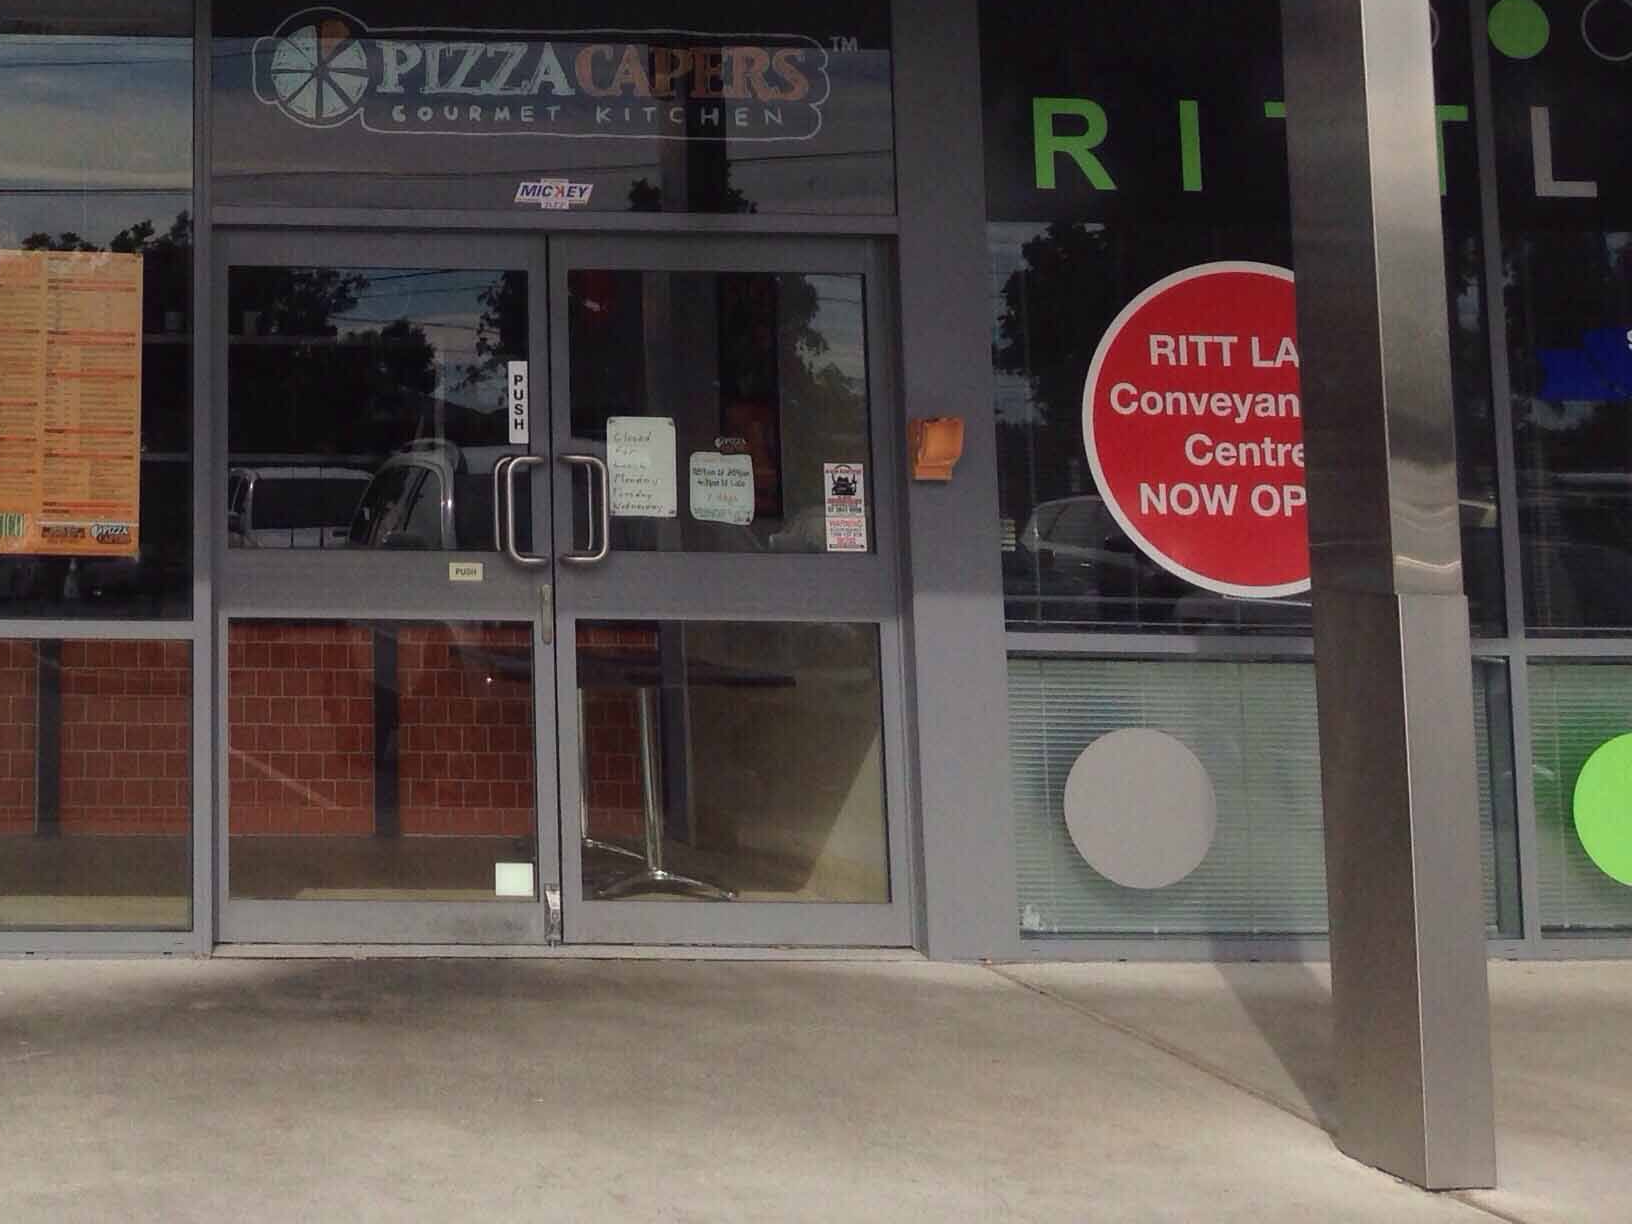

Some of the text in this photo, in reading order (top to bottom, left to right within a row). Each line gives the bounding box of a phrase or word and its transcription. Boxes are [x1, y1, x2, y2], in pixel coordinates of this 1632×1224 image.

[376, 41, 576, 96] PIZZA
[574, 44, 809, 102] CAPERS
[392, 104, 784, 126] GOURMET KITCHEN
[519, 184, 589, 199] MICKEY
[1149, 334, 1300, 368] RITT LA
[513, 374, 524, 430] PUSH
[1110, 382, 1302, 424] Conveyan
[1185, 433, 1305, 467] Centre
[1139, 482, 1307, 517] NOW OP
